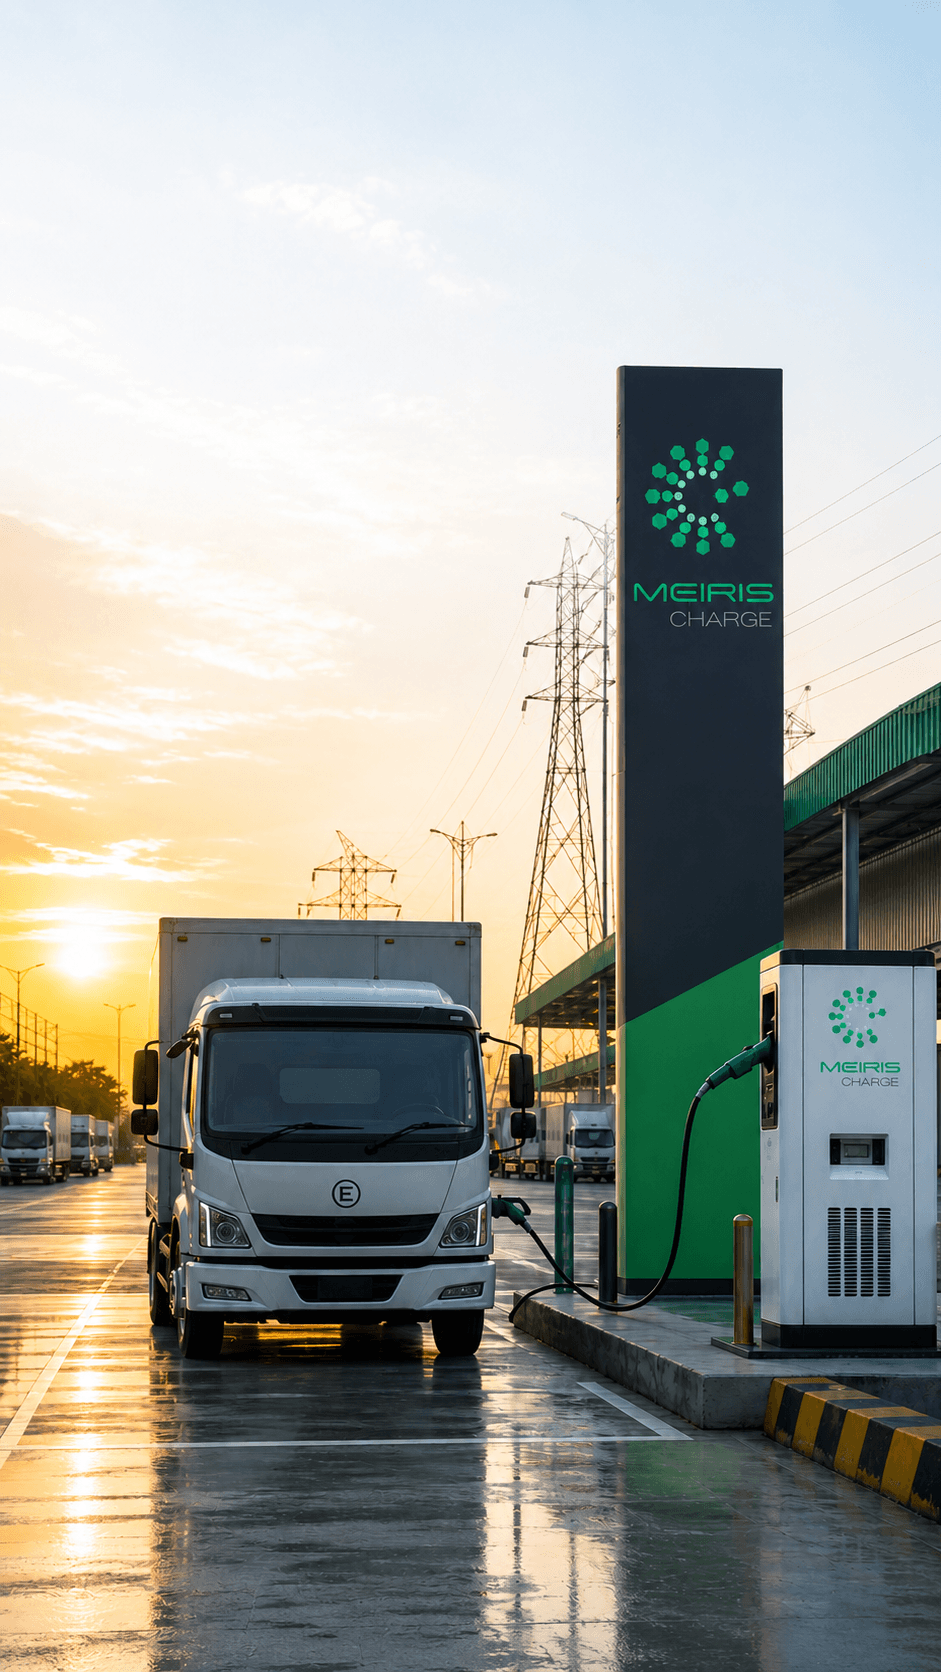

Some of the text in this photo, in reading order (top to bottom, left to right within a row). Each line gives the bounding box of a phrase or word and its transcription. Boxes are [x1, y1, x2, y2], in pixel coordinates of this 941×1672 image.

[633, 583, 774, 603] MEIRIS
[669, 611, 773, 627] CHARGE
[820, 1061, 901, 1073] MEIRIS
[841, 1077, 899, 1087] CHARGE
[339, 1186, 354, 1202] E
